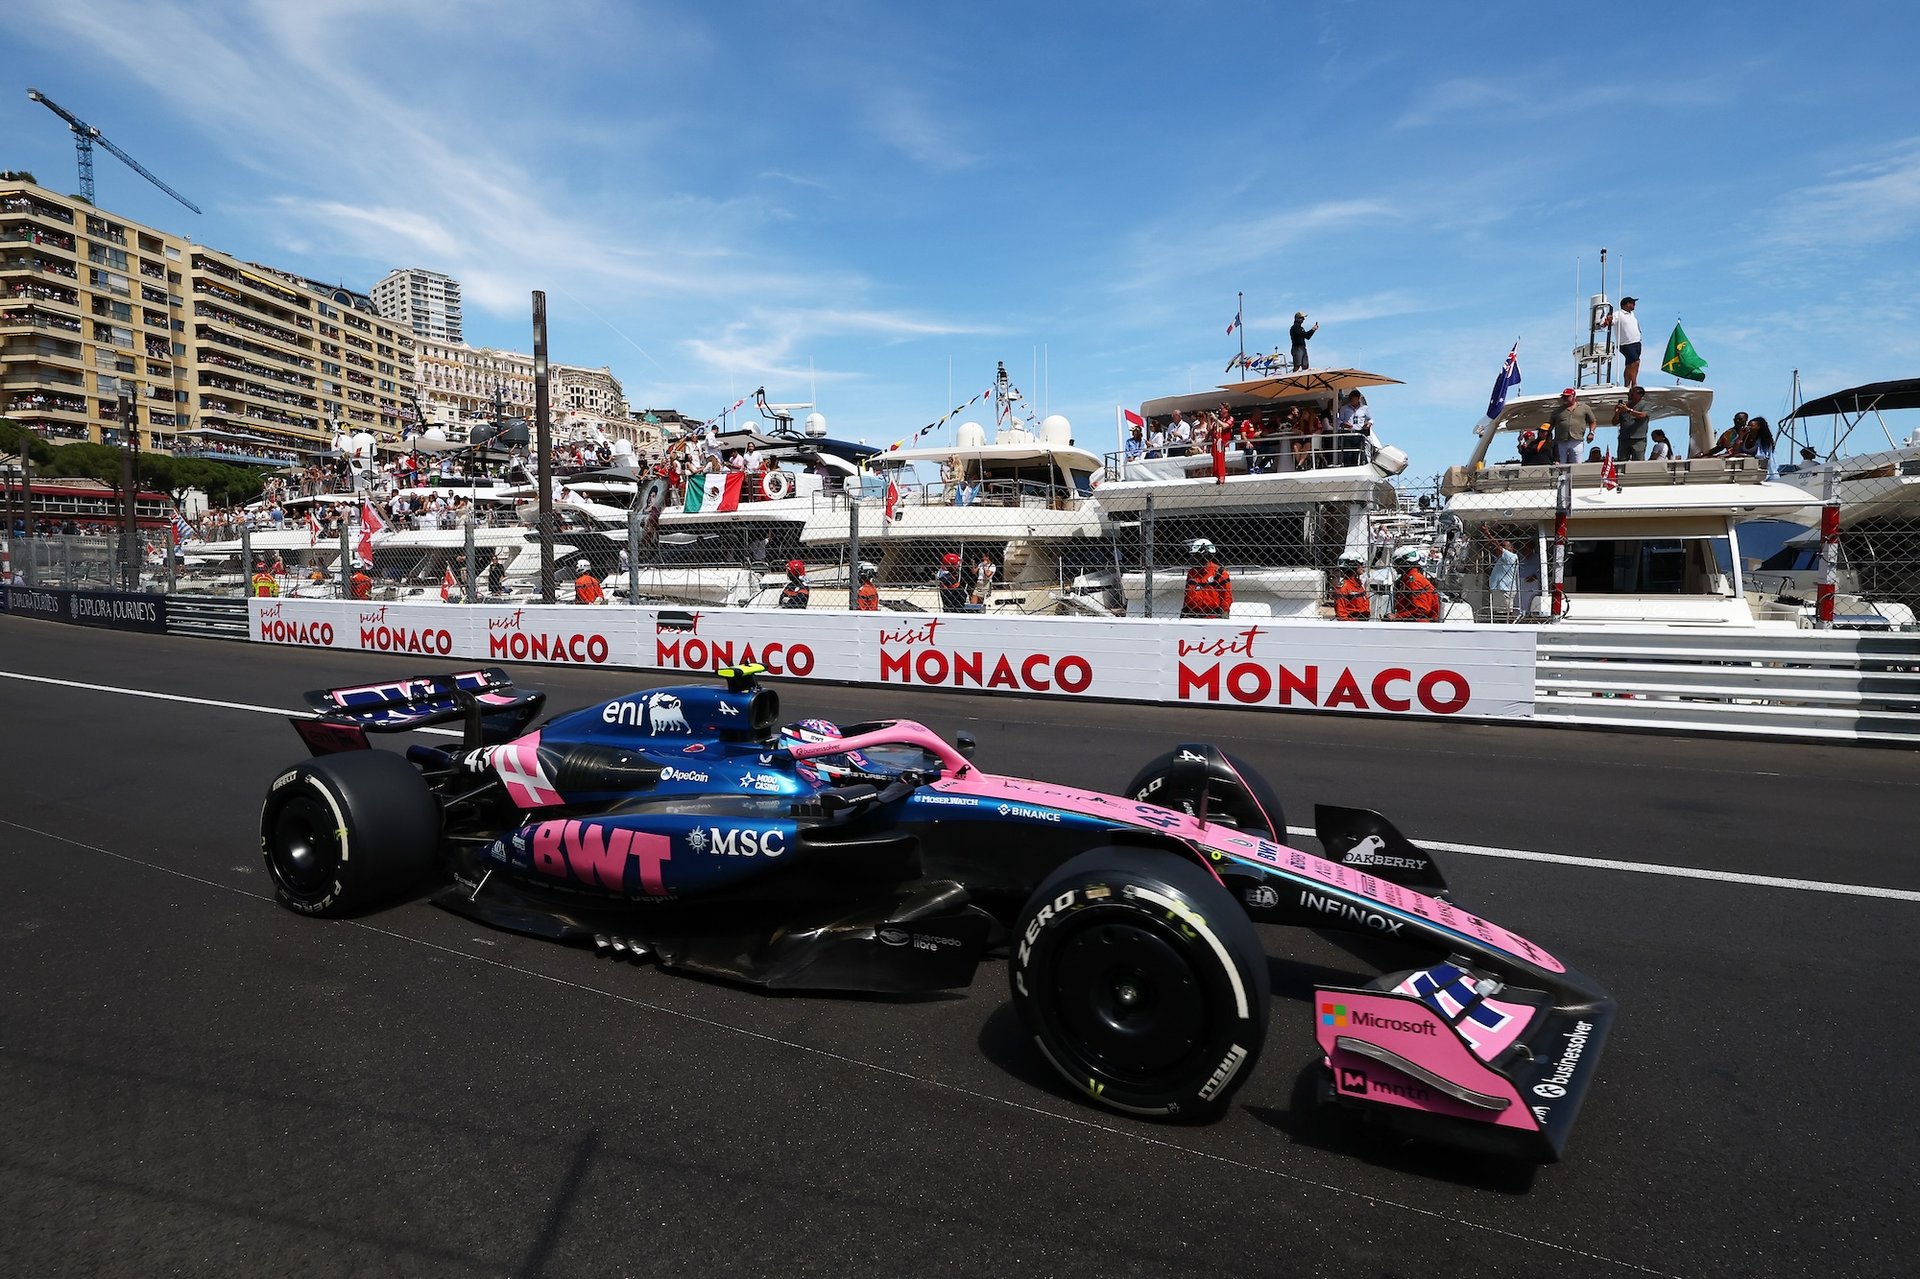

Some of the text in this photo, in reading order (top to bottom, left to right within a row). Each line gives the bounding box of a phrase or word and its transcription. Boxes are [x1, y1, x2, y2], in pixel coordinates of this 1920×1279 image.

[79, 598, 156, 622] EXPLORA JOURNEYS
[260, 602, 282, 619] visit
[360, 605, 388, 624] visit
[489, 608, 526, 630] visit
[261, 620, 334, 645] MONACO
[360, 626, 452, 655] MONACO
[880, 617, 946, 646] visit
[1178, 625, 1268, 658] visit
[489, 632, 609, 663] MONACO
[656, 638, 815, 677] MONACO
[880, 648, 1092, 693] MONACO
[1178, 660, 1471, 714] MONACO
[603, 694, 649, 726] eni
[273, 770, 297, 791] PIRELLI
[672, 768, 708, 783] ApeCoin
[755, 782, 780, 792] CASINO
[757, 774, 777, 784] MODO
[1011, 806, 1061, 822] BINANCE
[710, 827, 785, 857] MSC
[1257, 840, 1279, 862] BWT
[533, 819, 671, 895] BWT
[1343, 852, 1428, 871] OAKBERRY
[1299, 889, 1404, 936] INFINOX
[913, 933, 962, 947] mercado
[1017, 890, 1075, 968] ZERO
[914, 940, 938, 952] libre
[1352, 1010, 1437, 1037] Microsoft
[1552, 1020, 1594, 1086] businessolver
[1198, 1043, 1248, 1101] PIRELLI
[1373, 1080, 1429, 1102] mntn
